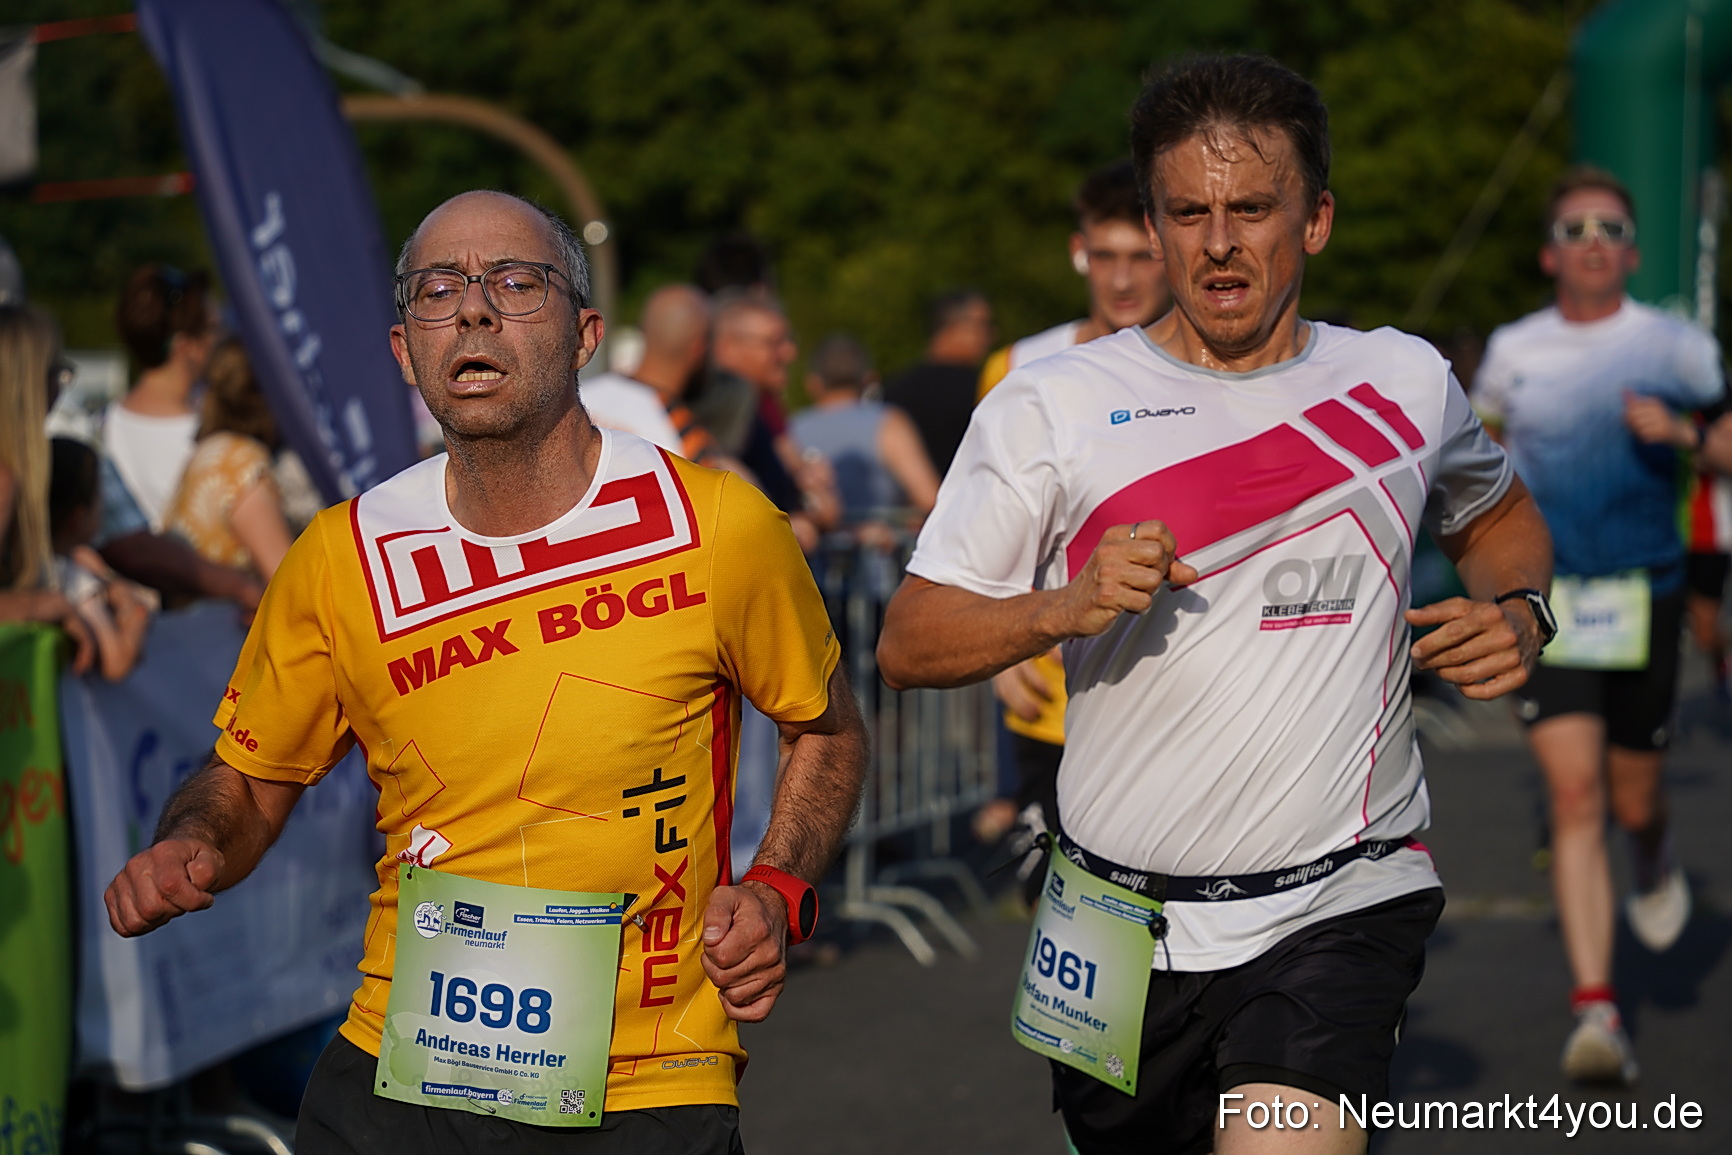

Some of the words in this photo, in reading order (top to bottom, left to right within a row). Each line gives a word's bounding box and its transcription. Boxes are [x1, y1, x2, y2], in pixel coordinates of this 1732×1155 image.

[387, 618, 520, 696] MAX
[537, 571, 706, 644] BÖGL
[1273, 857, 1334, 888] sailfish
[444, 922, 508, 942] Firmenlauf
[464, 939, 505, 949] neumarkt
[1031, 928, 1097, 1000] 1961
[429, 970, 553, 1034] 1698
[1052, 996, 1108, 1032] Munker
[415, 1028, 491, 1059] Andreas
[495, 1043, 567, 1068] Herrler
[447, 1058, 461, 1067] Bögl
[461, 1060, 494, 1072] Bauservice
[494, 1067, 513, 1075] GmbH
[425, 1085, 495, 1099] firmenlauf.bayern
